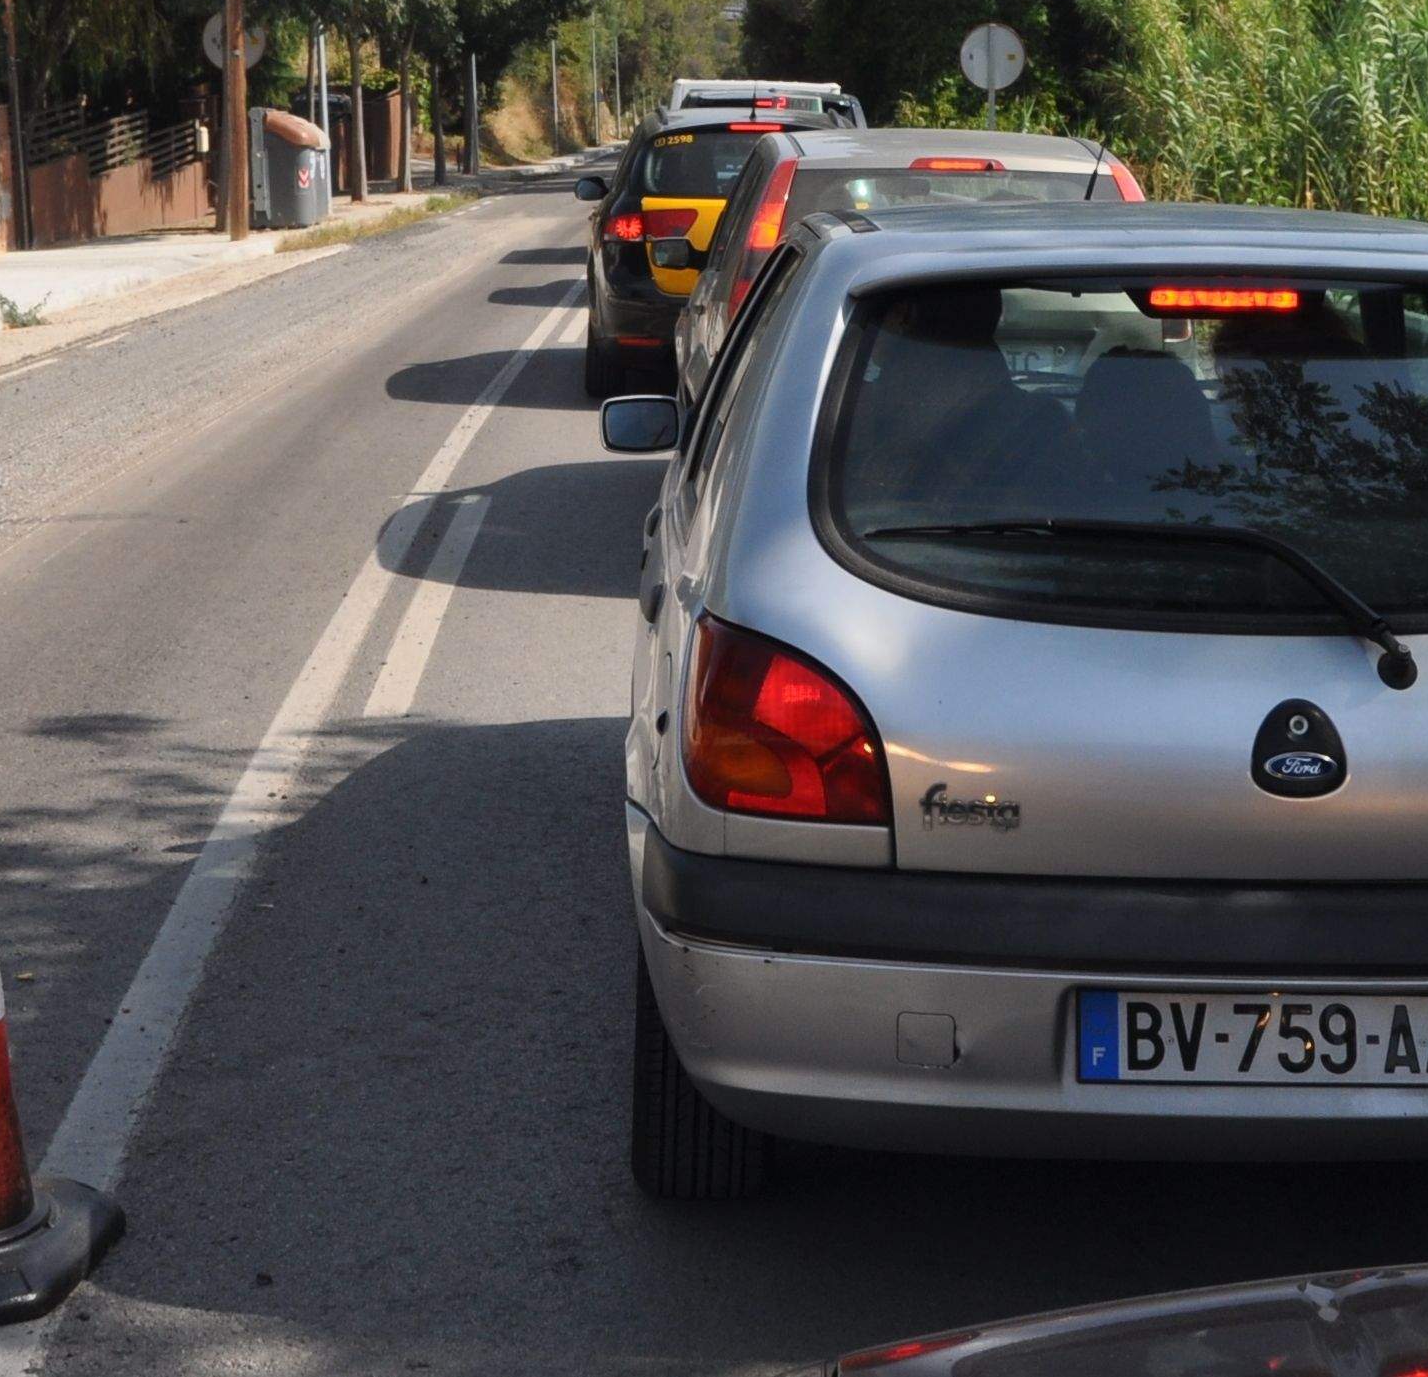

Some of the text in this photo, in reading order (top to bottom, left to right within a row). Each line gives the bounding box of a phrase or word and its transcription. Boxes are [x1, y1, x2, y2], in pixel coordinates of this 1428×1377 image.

[667, 134, 693, 145] 2598
[1281, 757, 1321, 775] Ford
[1092, 1046, 1106, 1066] F
